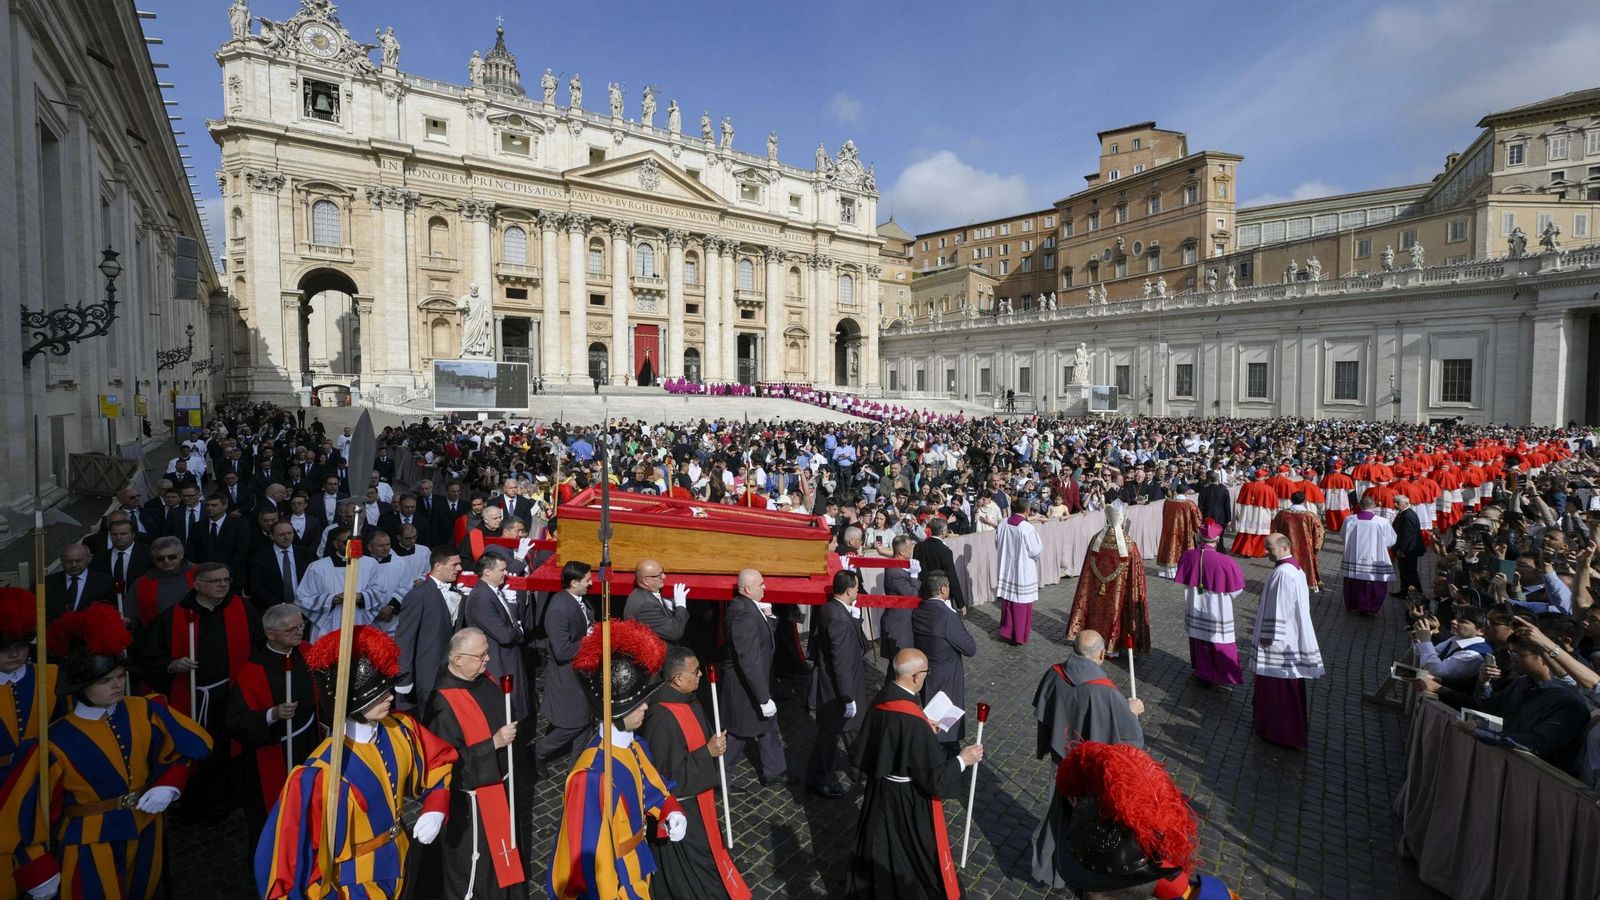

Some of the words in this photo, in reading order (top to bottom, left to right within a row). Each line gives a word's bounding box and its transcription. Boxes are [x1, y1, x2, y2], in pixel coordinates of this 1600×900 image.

[382, 160, 398, 170] IN
[473, 176, 533, 194] PRINCIPIS
[534, 186, 567, 199] APOST
[571, 190, 605, 203] PAVLVS
[615, 198, 675, 216] BVRGHESIVS
[675, 209, 719, 222] ROMANVS
[739, 222, 756, 232] MAX
